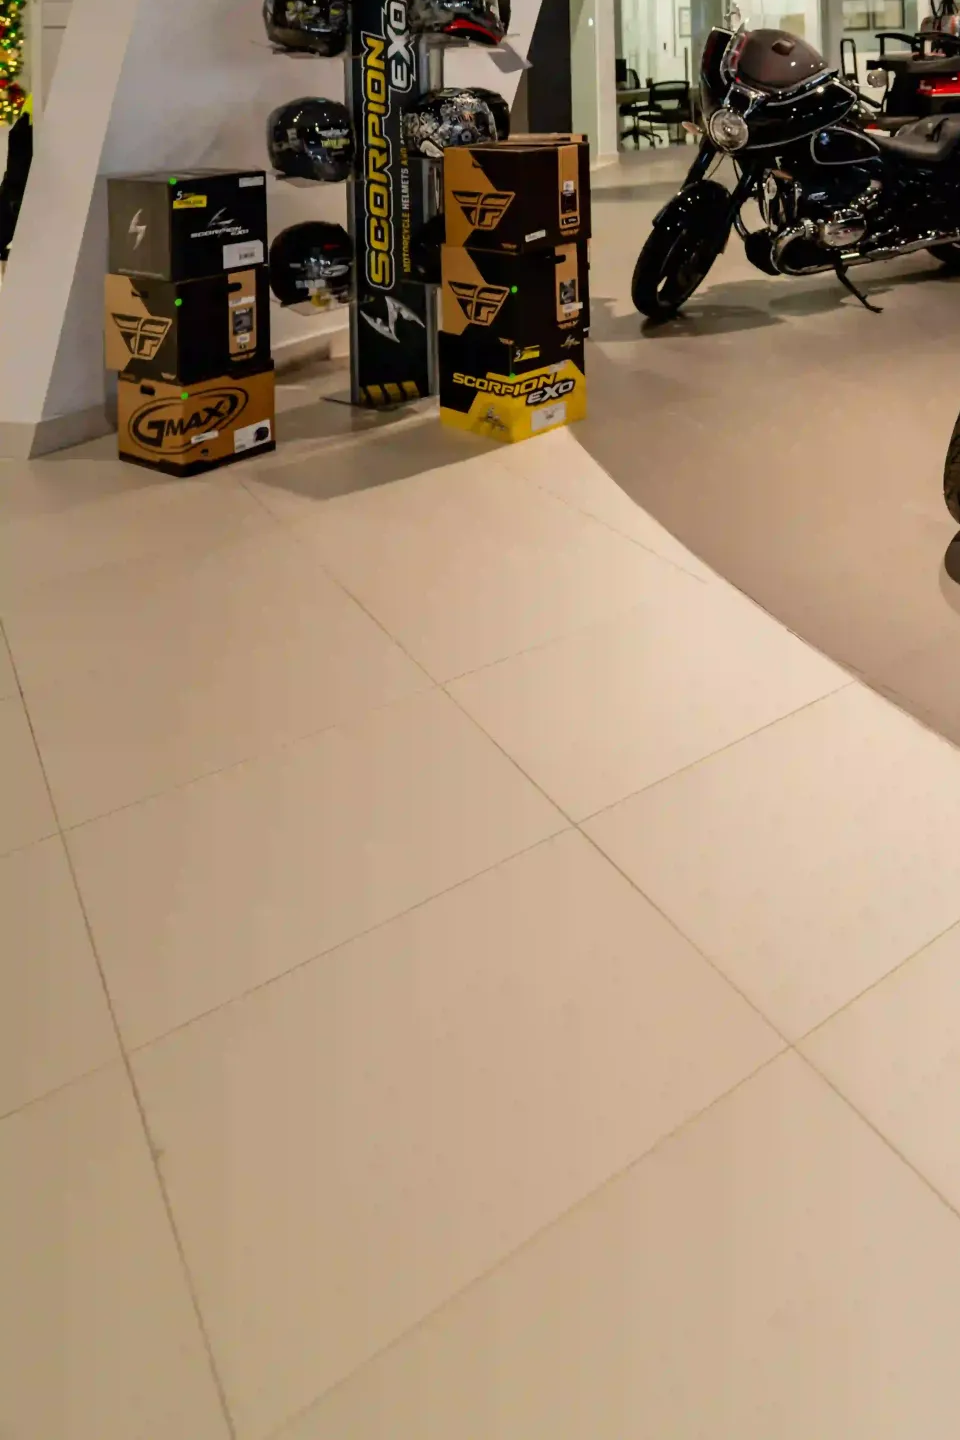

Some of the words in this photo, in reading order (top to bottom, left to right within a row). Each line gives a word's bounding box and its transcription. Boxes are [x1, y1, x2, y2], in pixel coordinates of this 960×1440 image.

[364, 35, 392, 288] SCORPION
[400, 167, 410, 210] HELMETS
[402, 212, 411, 273] MOTORCYCLE
[452, 372, 557, 396] SCORPION
[526, 380, 575, 405] EXO
[132, 398, 229, 448] GMAX
